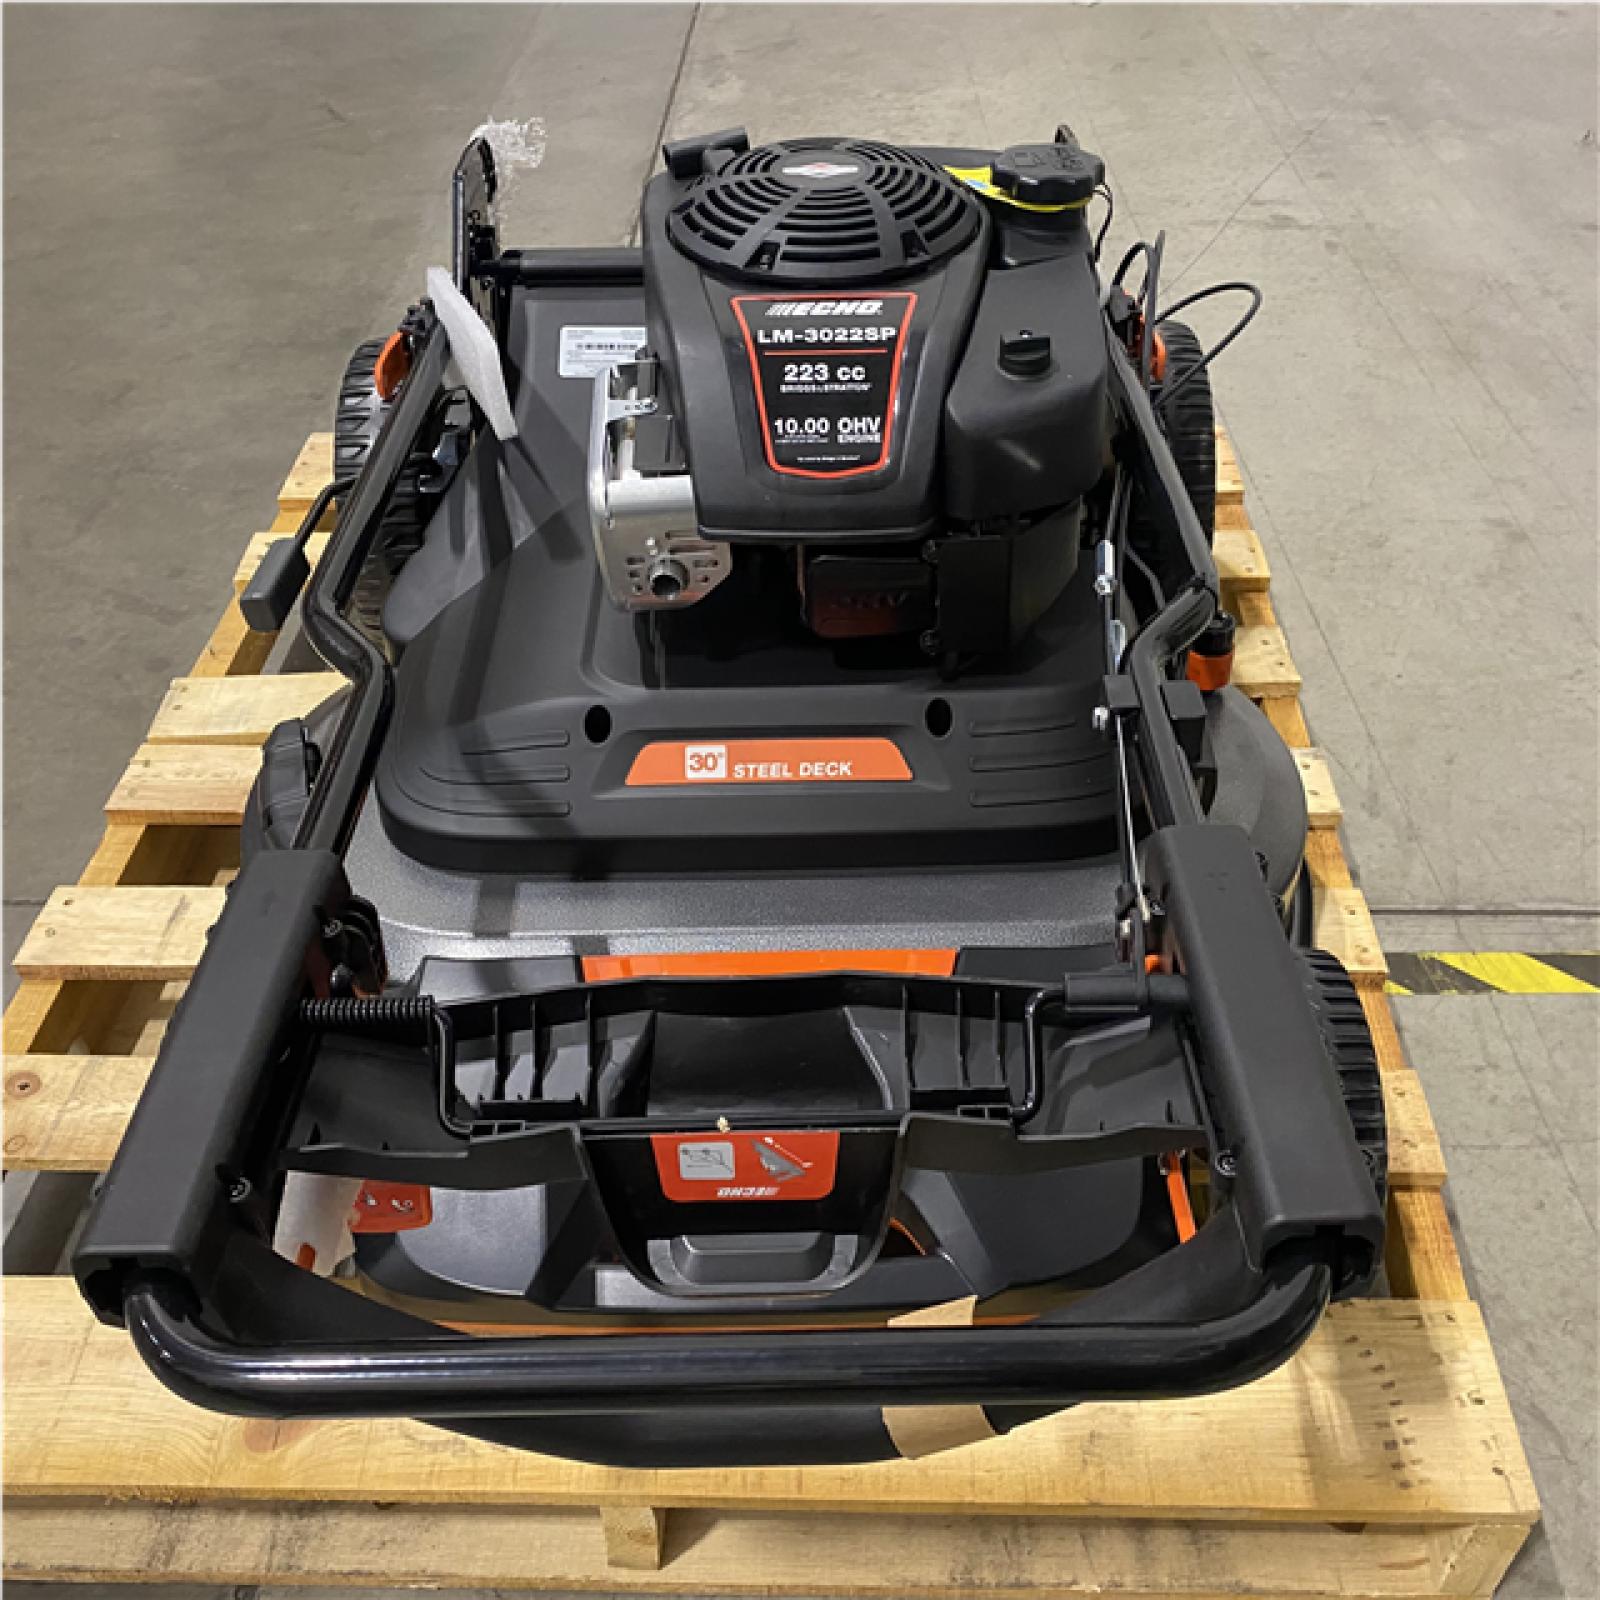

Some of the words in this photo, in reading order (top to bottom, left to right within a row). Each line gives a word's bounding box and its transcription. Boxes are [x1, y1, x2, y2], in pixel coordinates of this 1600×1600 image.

[765, 300, 883, 316] ECHO
[757, 327, 897, 344] LM-3022SP
[784, 363, 830, 382] 223
[837, 366, 866, 381] cc
[774, 417, 830, 435] 10.00
[837, 416, 881, 434] OHV
[734, 762, 793, 778] STEEL
[799, 759, 853, 777] DECK
